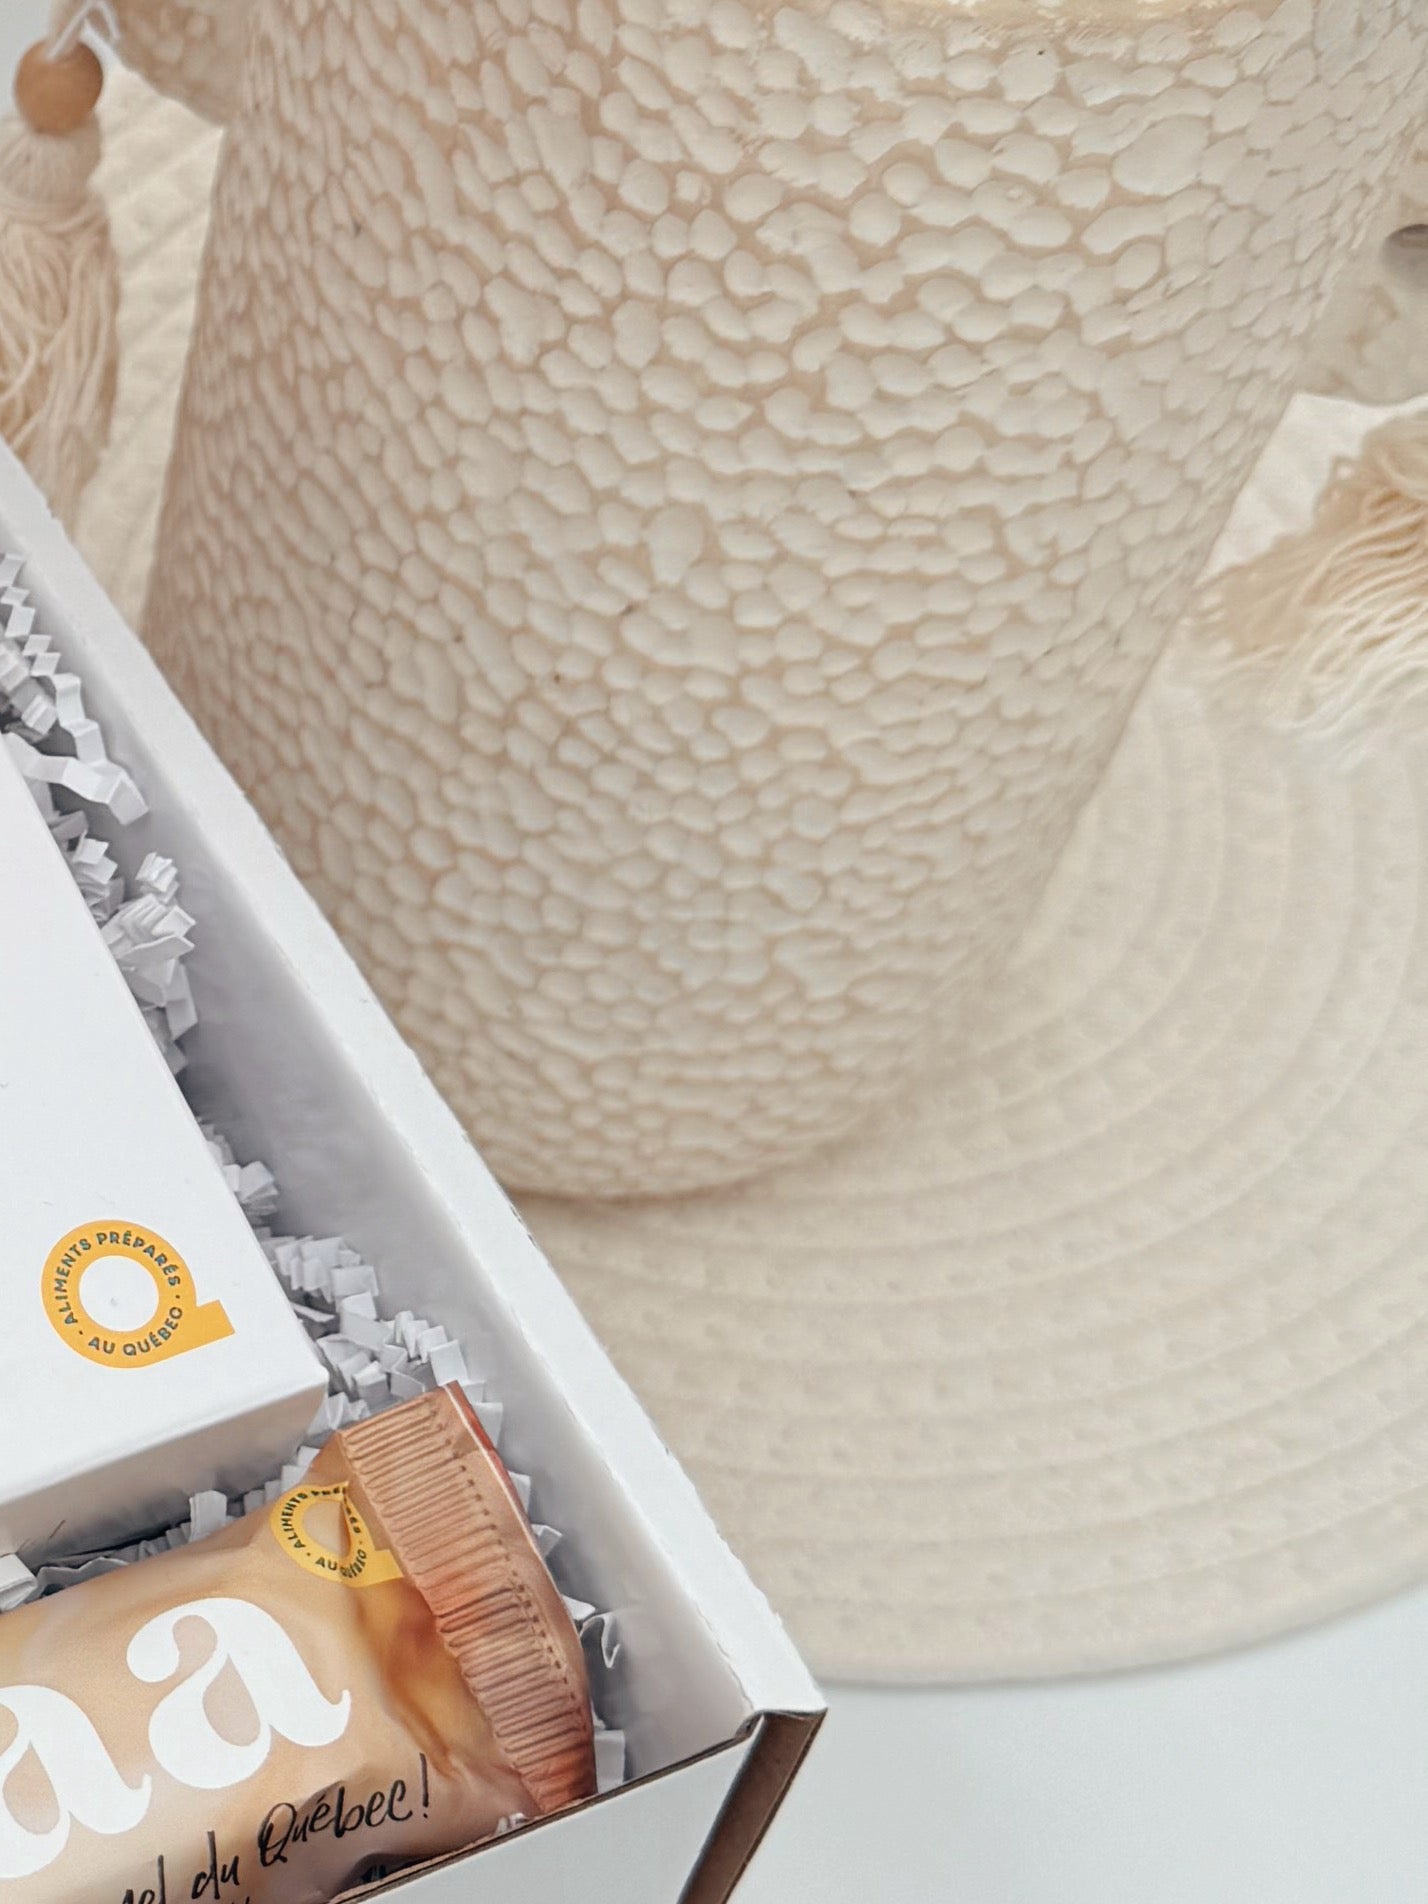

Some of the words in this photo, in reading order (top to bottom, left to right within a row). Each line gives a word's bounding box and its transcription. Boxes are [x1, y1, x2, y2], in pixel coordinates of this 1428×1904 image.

[54, 1238, 91, 1325] ALIMENTS
[88, 1337, 115, 1355] AU
[315, 1556, 338, 1571] AU
[191, 1828, 241, 1903] du
[258, 1752, 431, 1871] Québec!
